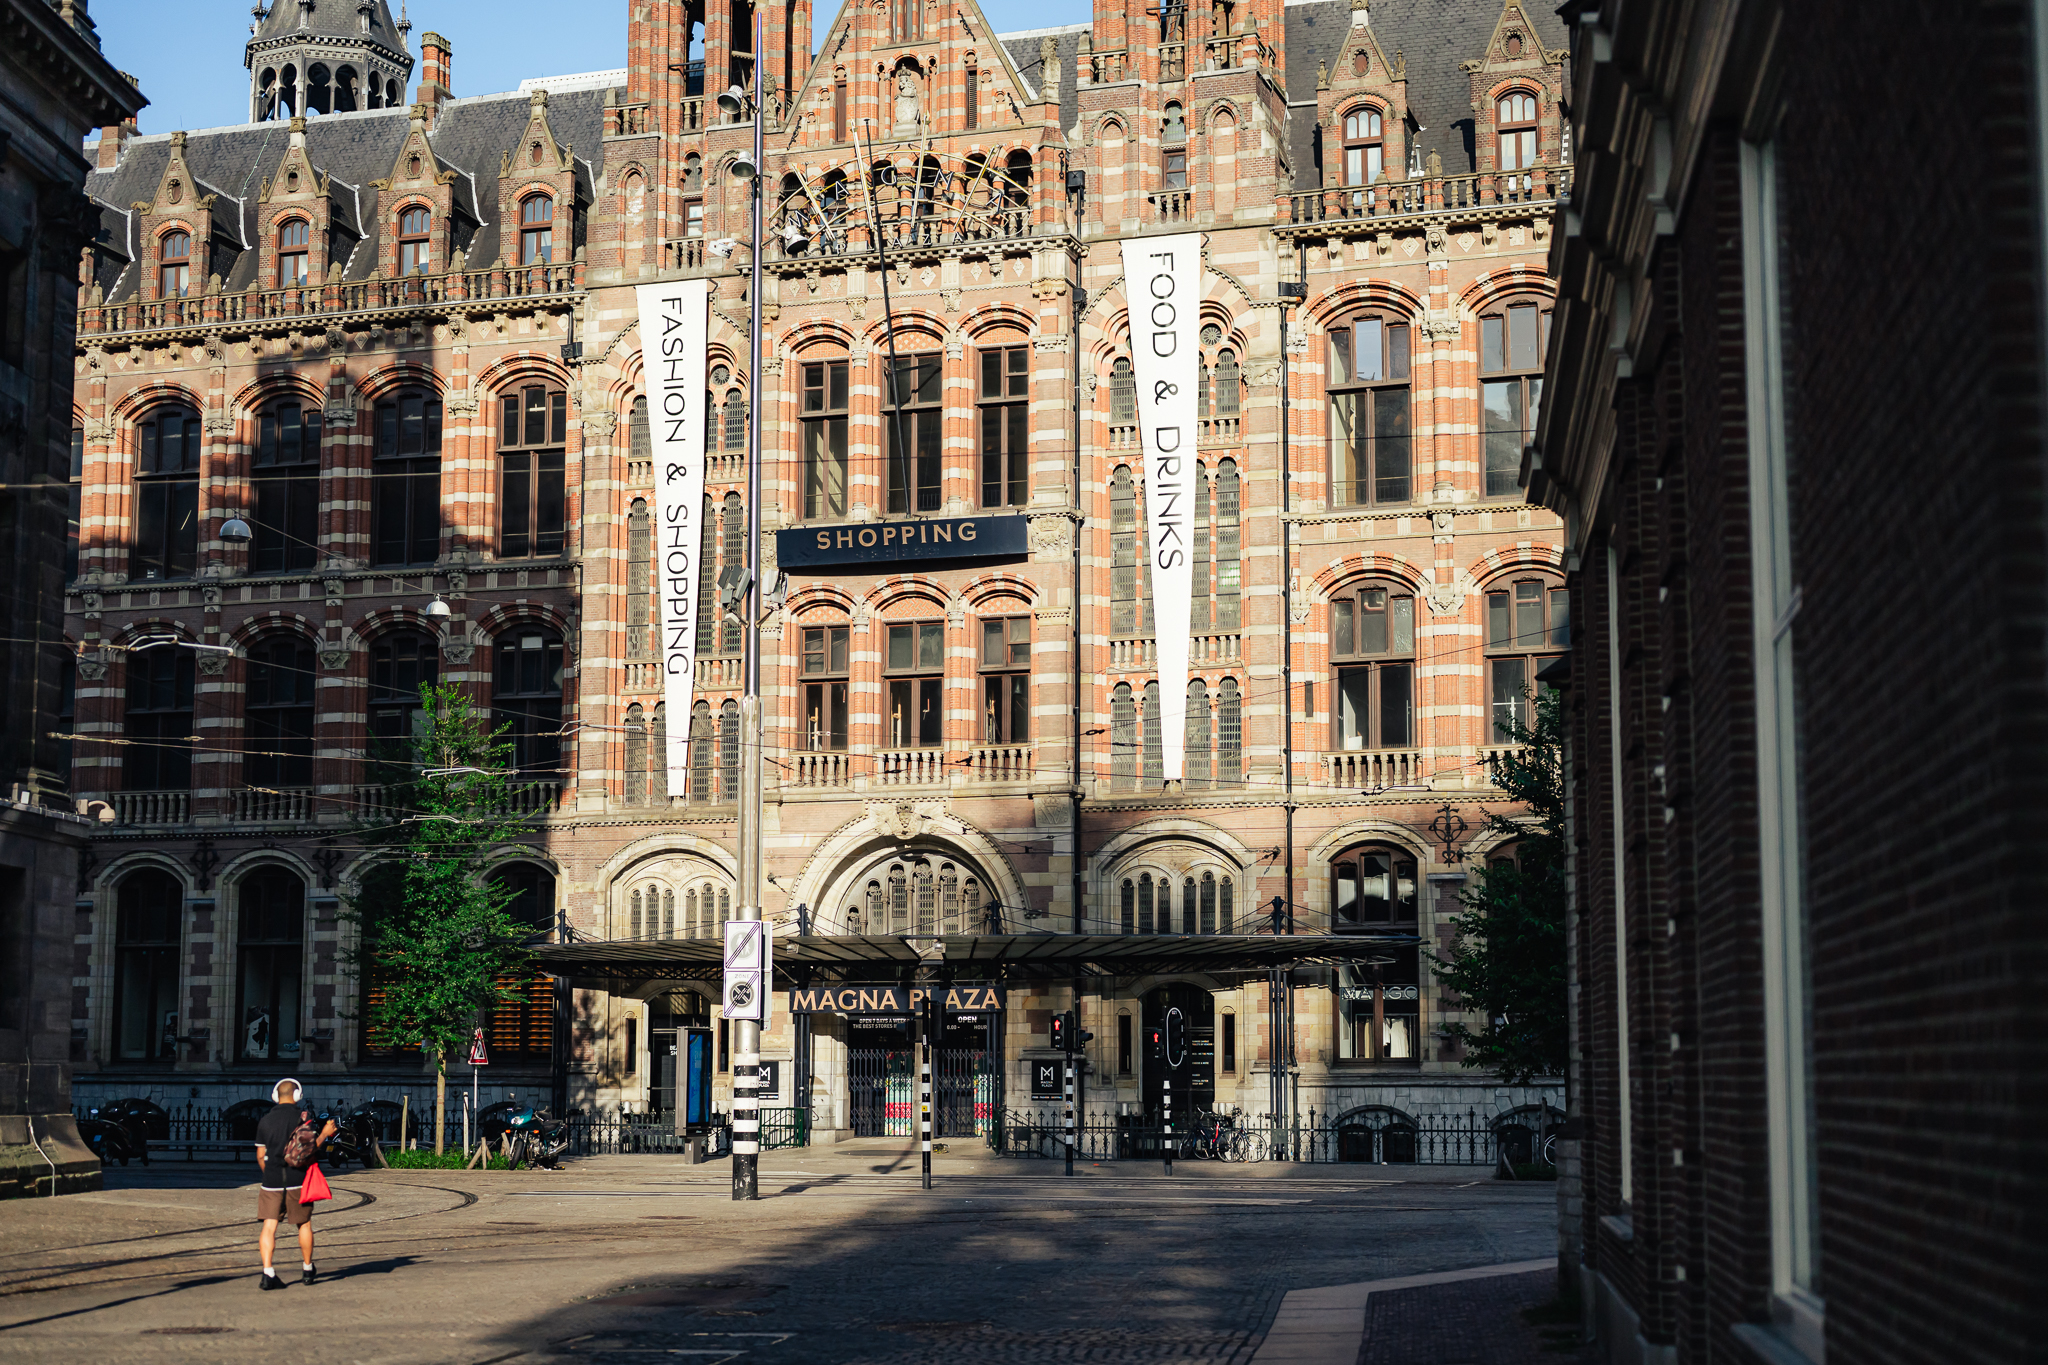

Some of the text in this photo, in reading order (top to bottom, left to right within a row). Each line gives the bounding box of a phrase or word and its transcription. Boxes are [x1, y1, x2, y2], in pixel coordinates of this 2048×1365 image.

[661, 297, 688, 676] FASHION & SHOPPING
[1149, 252, 1184, 570] FOOD & DRINKS
[817, 522, 977, 549] SHOPPING
[793, 989, 899, 1010] MAGNA
